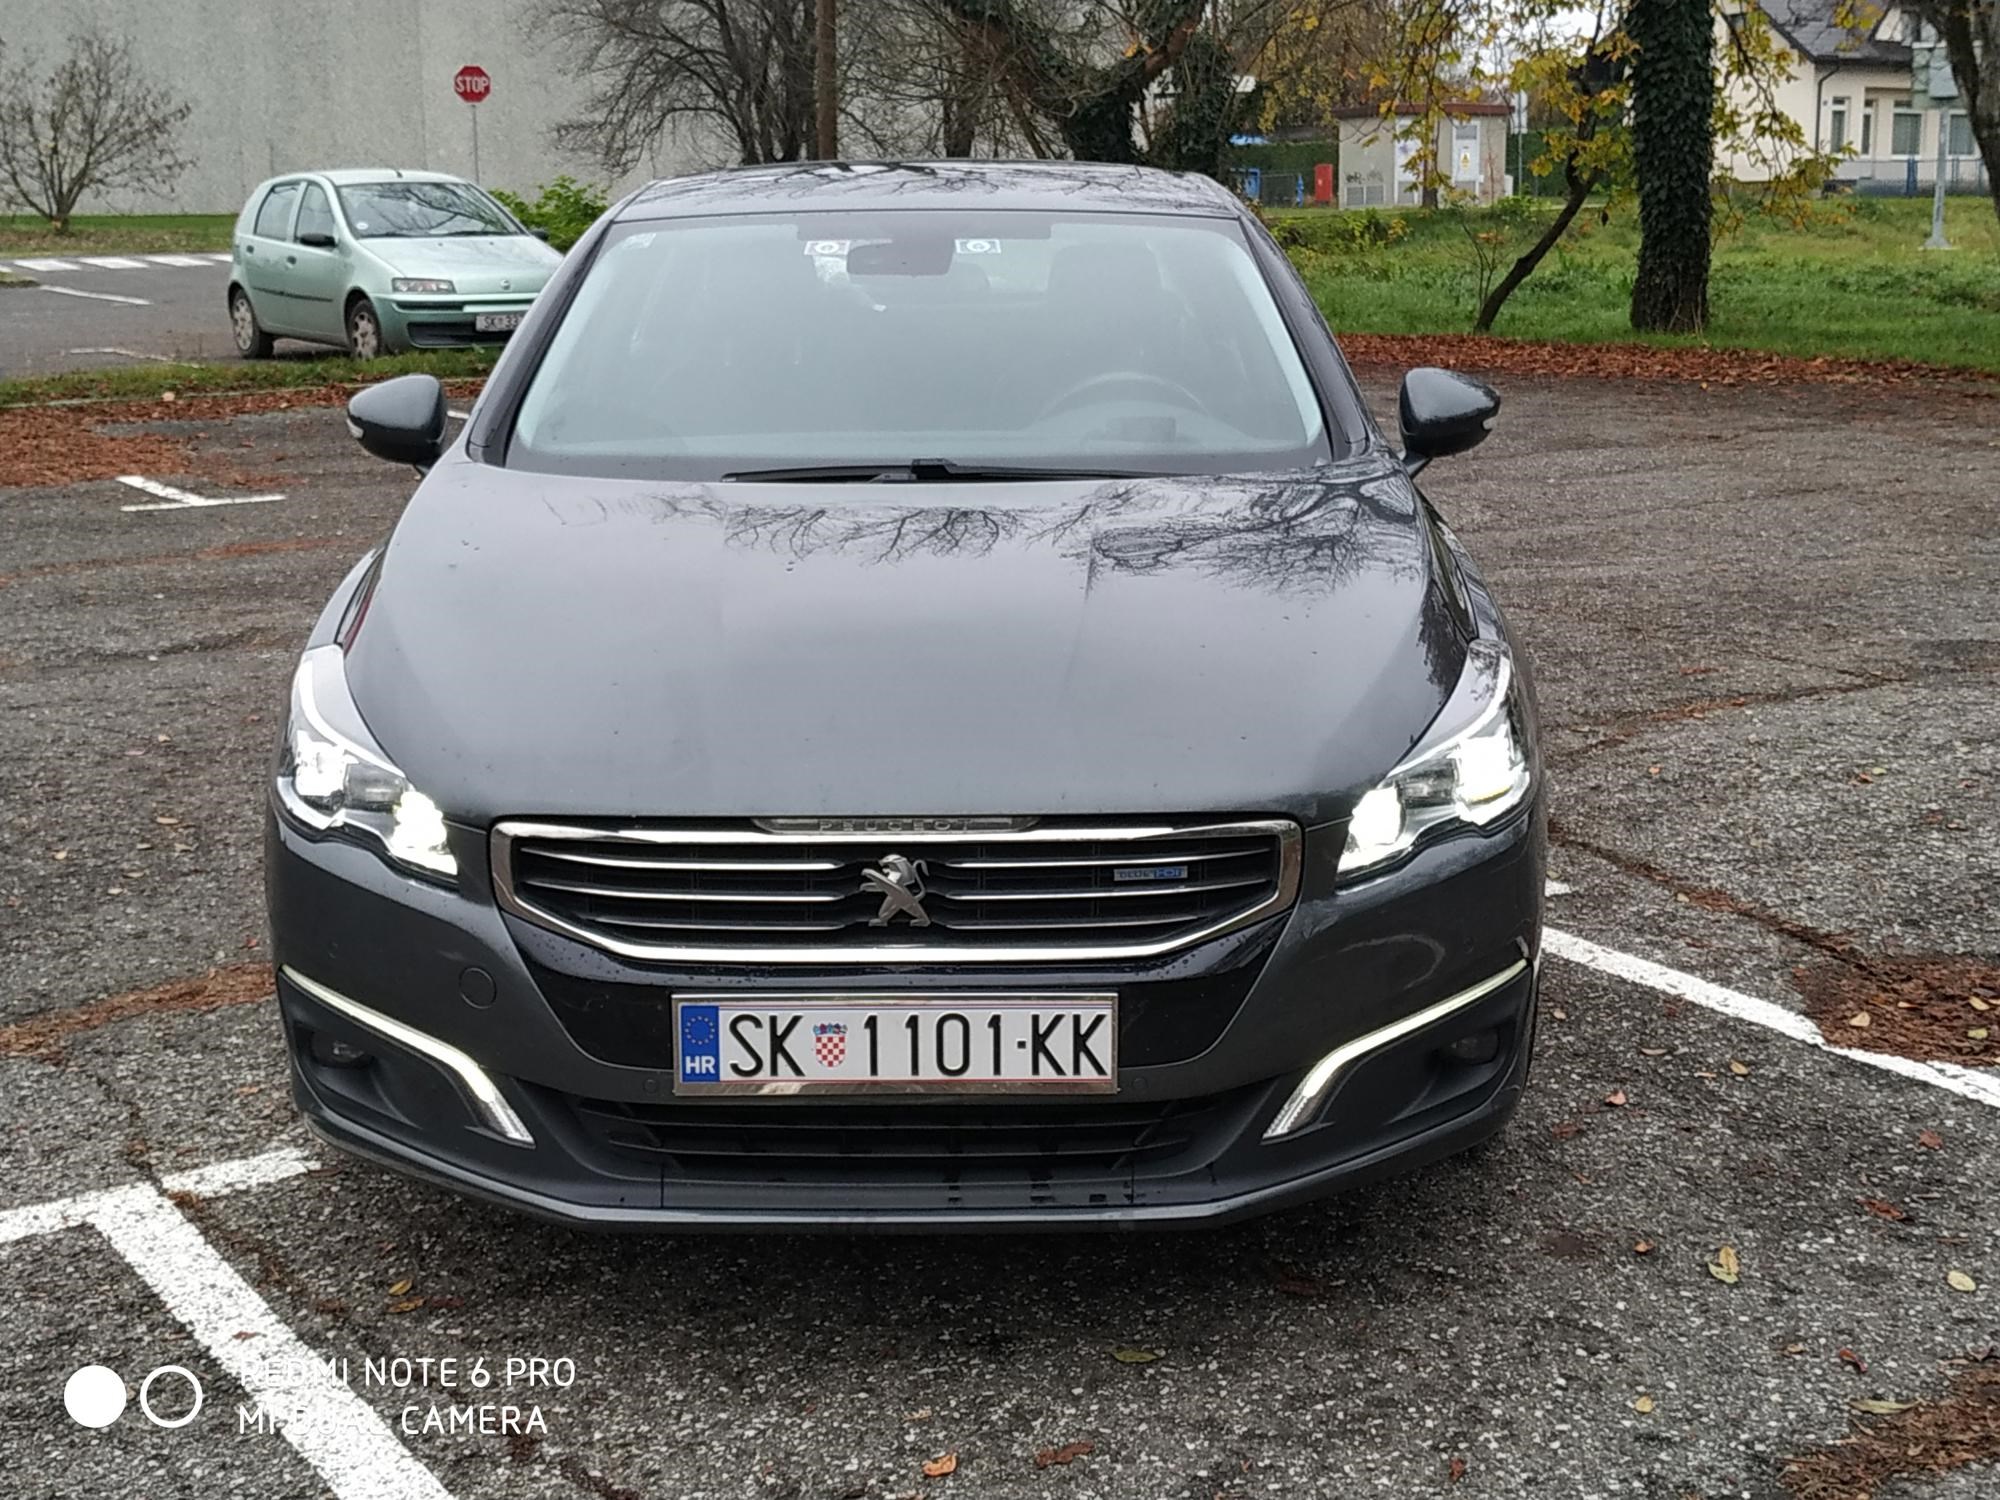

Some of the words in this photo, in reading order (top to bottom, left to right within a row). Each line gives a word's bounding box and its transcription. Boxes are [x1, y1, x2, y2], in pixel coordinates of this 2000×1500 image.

[455, 76, 488, 93] STOP
[729, 1013, 805, 1077] SK
[685, 1056, 716, 1075] HR
